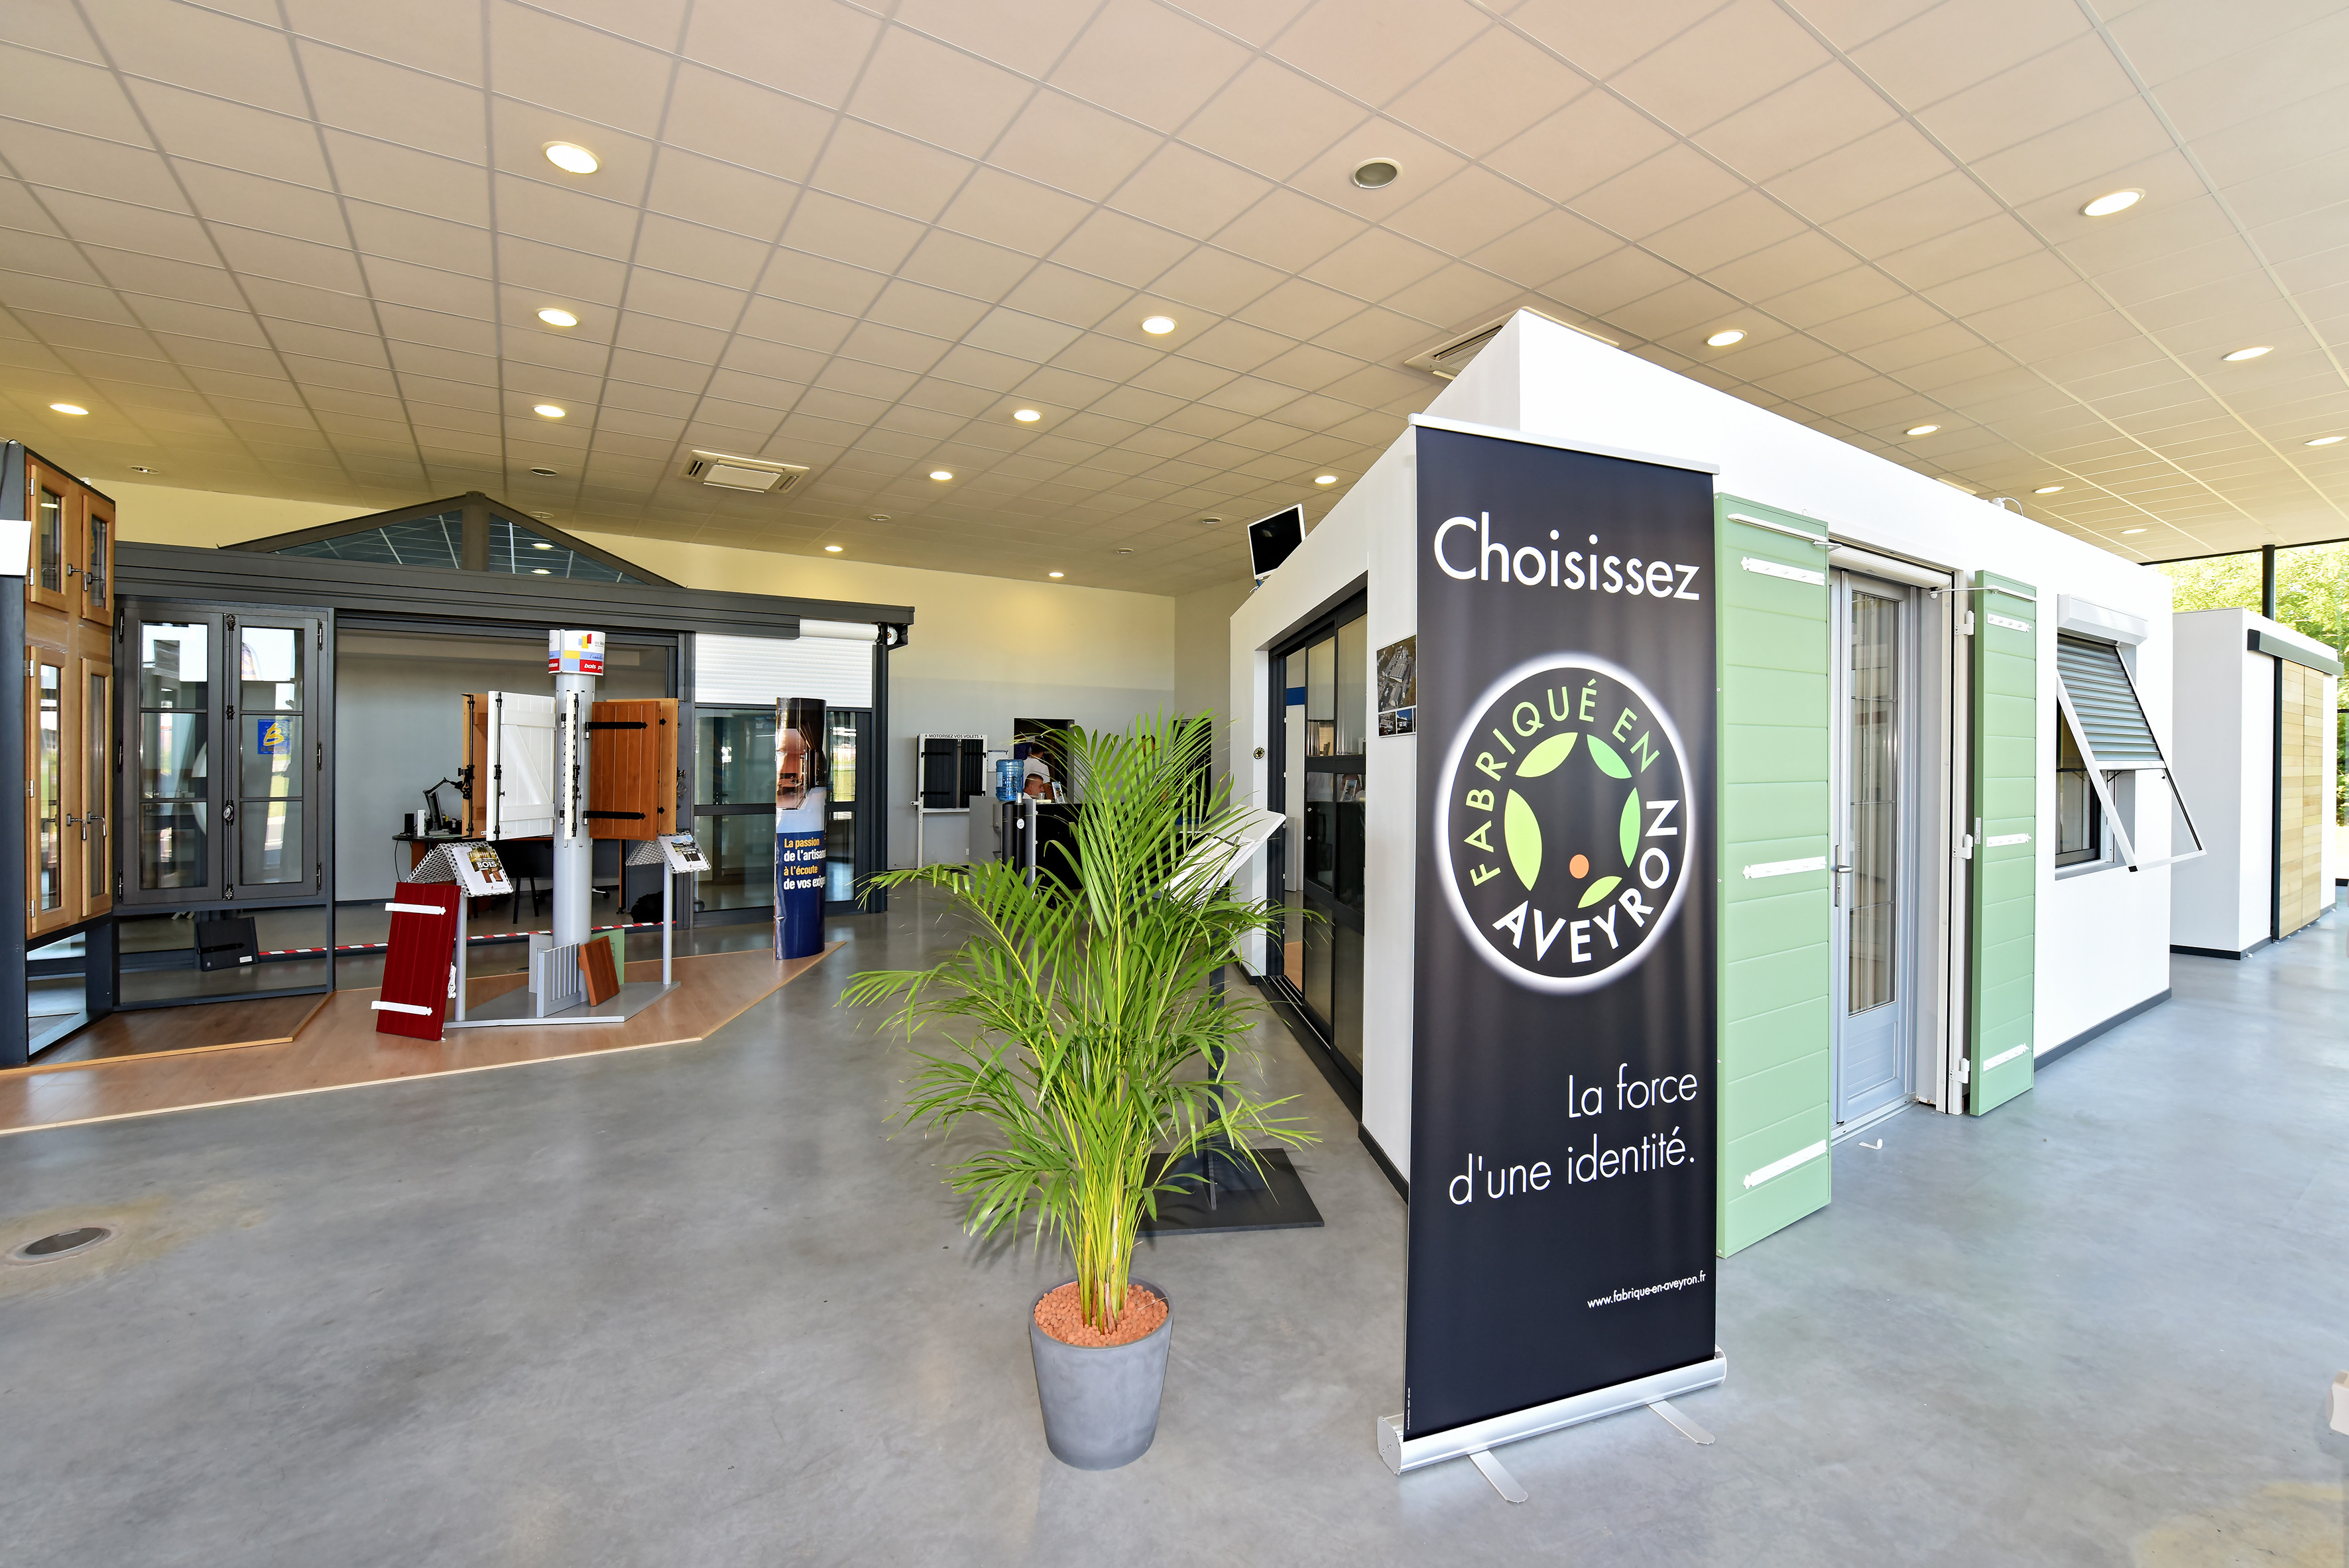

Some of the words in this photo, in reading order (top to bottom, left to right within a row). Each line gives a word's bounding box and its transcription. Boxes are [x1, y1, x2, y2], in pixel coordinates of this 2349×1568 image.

[1433, 511, 1700, 601] Choisissez
[1464, 678, 1597, 887] FABRIQUÉ
[1612, 707, 1660, 773] EN
[784, 838, 794, 848] La
[795, 837, 820, 849] passion
[784, 850, 796, 862] de
[783, 878, 796, 890] de
[796, 878, 812, 889] vos
[784, 866, 789, 876] à
[790, 865, 818, 875] l'écoute
[1492, 800, 1679, 963] AVEYRON
[1569, 1074, 1602, 1118] La
[1616, 1063, 1698, 1111] force
[1449, 1153, 1552, 1205] d'une
[1567, 1126, 1695, 1185] identité.
[1587, 1270, 1707, 1309] www.fabrique-en-aveyron.fr
